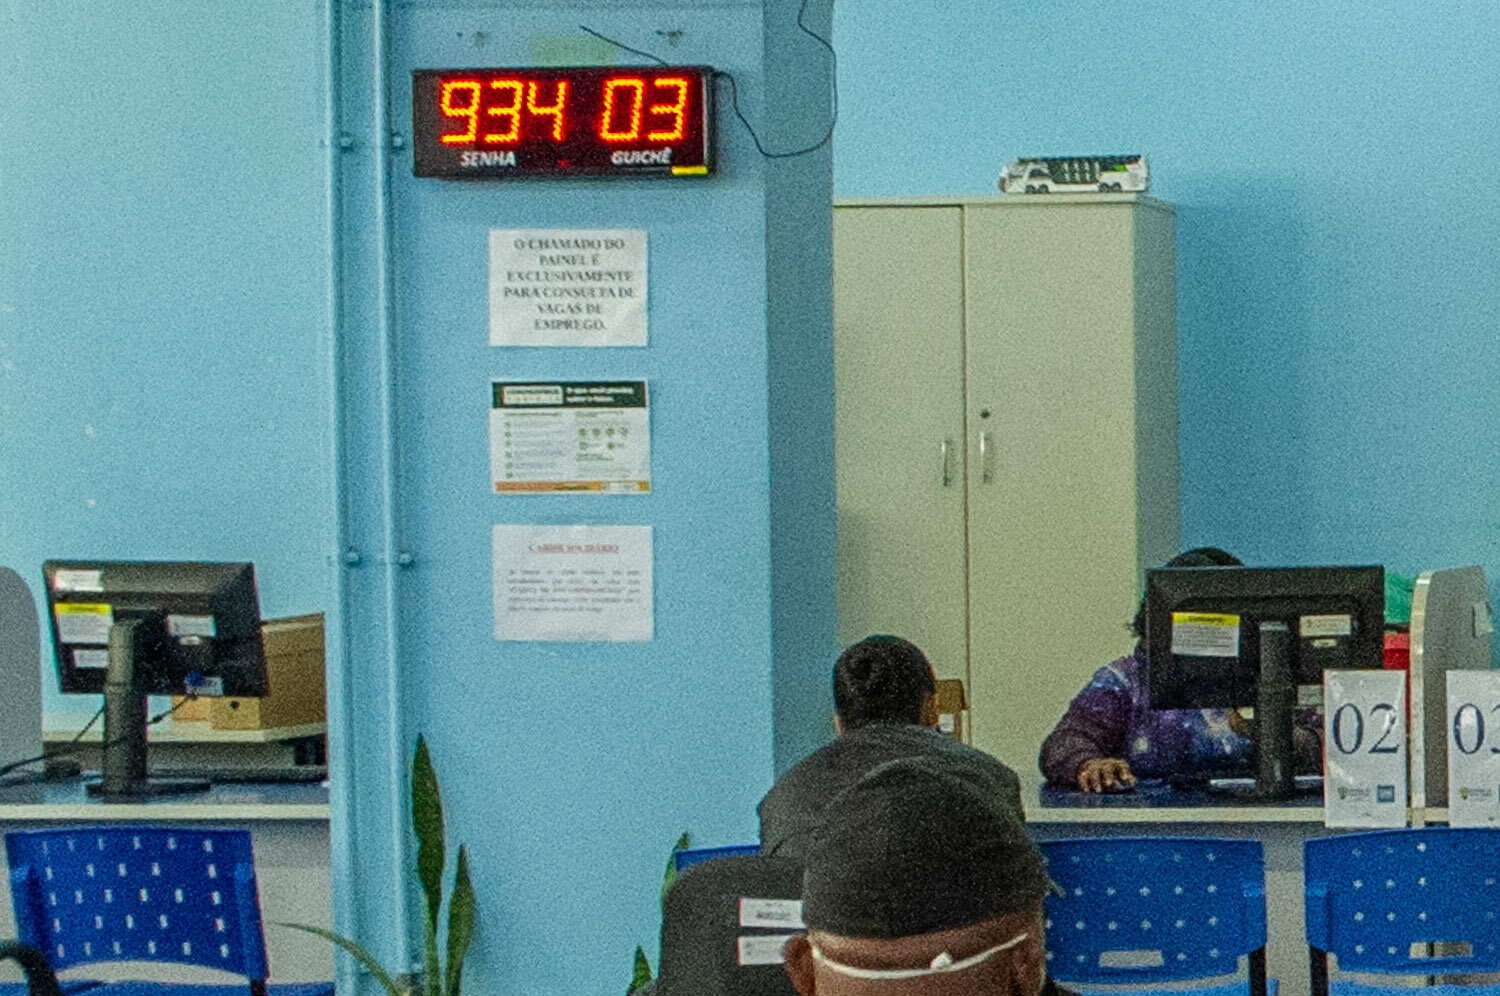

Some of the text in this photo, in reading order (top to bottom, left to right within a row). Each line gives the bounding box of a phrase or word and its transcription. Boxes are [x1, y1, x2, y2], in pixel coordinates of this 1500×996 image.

[440, 77, 689, 145] 934 03
[460, 151, 516, 167] SENHA
[514, 238, 626, 250] O CHAMADO DO
[539, 254, 589, 266] PAINEL
[506, 270, 634, 282] EXCLUSIVAMENTE
[504, 286, 634, 299] PARA CONSULTA DE
[536, 303, 602, 314] VAGAS DE
[1332, 703, 1400, 755] 02
